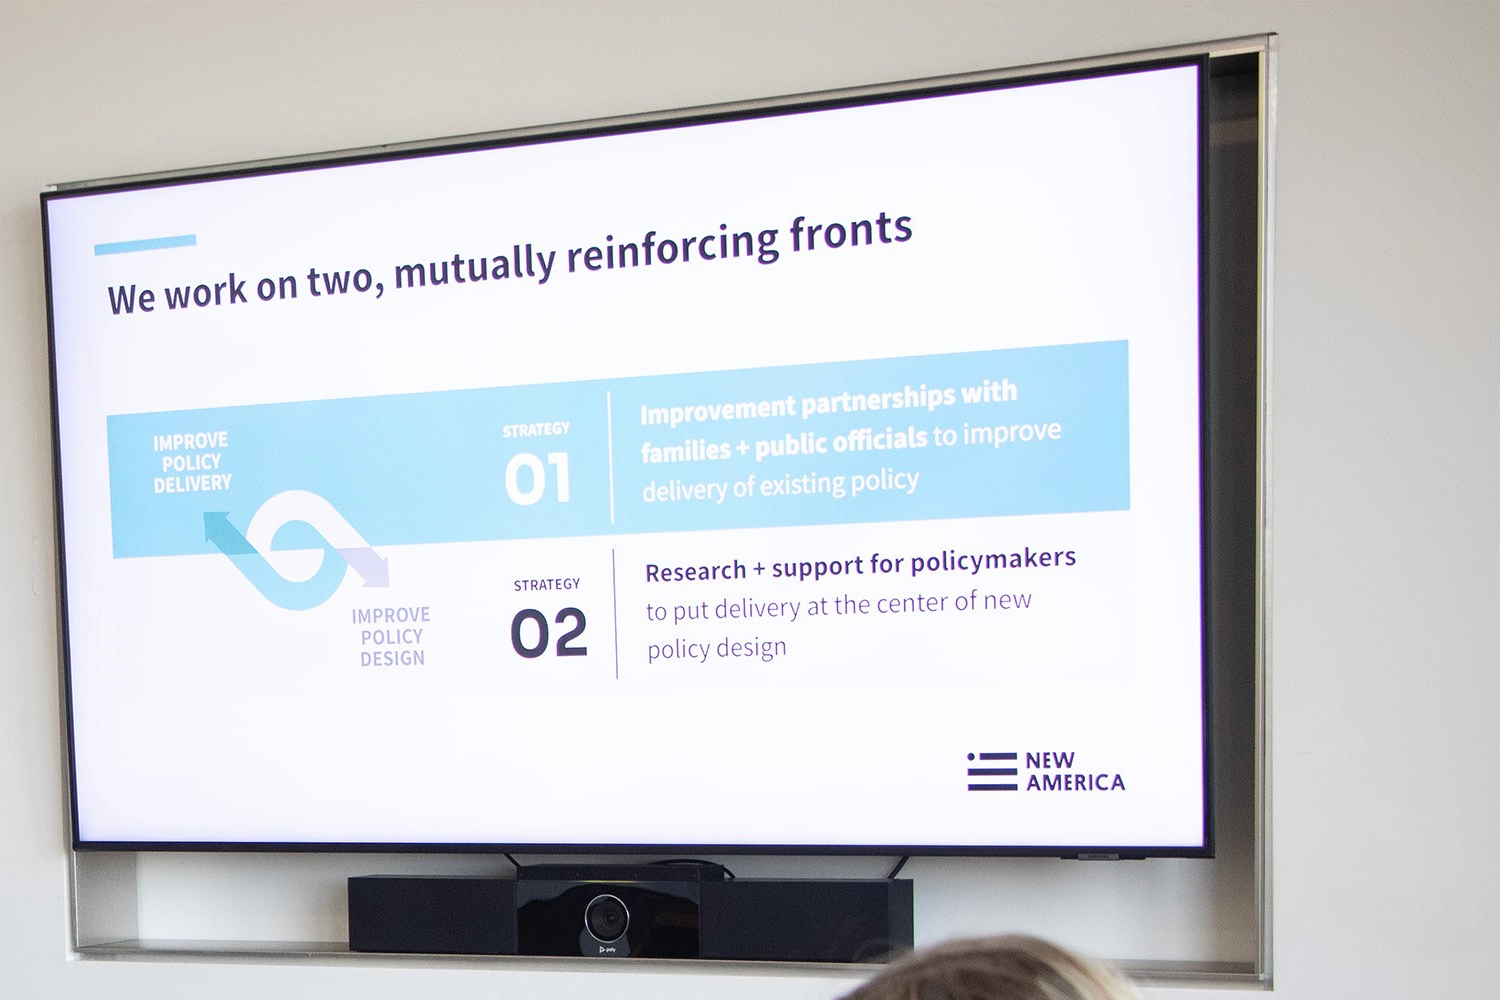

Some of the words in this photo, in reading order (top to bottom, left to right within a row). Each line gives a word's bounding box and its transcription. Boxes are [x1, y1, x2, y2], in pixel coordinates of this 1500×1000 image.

[107, 284, 156, 316] We
[163, 272, 248, 310] work
[256, 275, 298, 302] on
[306, 267, 384, 300] two,
[395, 243, 557, 289] mutually
[567, 223, 780, 273] reinforcing
[789, 211, 913, 253] fronts
[640, 395, 797, 429] Improvement
[801, 383, 956, 420] partnerships
[960, 378, 1018, 404] with
[502, 421, 570, 439] STRATEGY
[153, 431, 229, 452] IMPROVE
[640, 438, 732, 464] families
[735, 440, 750, 455] +
[755, 431, 828, 463] public
[832, 425, 928, 453] officials
[932, 426, 958, 447] to
[963, 422, 1062, 449] improve
[162, 453, 222, 472] POLICY
[154, 473, 232, 494] DELIVERY
[505, 451, 570, 506] 01
[642, 479, 729, 505] delivery
[733, 474, 756, 498] of
[759, 471, 846, 499] existing
[851, 467, 920, 497] policy
[646, 559, 746, 583] Research
[753, 561, 766, 576] +
[772, 555, 864, 582] support
[869, 552, 905, 574] for
[911, 546, 1076, 578] policymakers
[513, 577, 581, 592] STRATEGY
[352, 606, 431, 625] IMPROVE
[646, 603, 667, 622] to
[674, 601, 709, 626] put
[715, 597, 801, 623] delivery
[807, 597, 829, 616] at
[834, 593, 871, 615] the
[877, 593, 949, 614] center
[954, 588, 978, 611] of
[984, 593, 1032, 610] new
[361, 628, 424, 646] POLICY
[510, 606, 588, 659] 02
[360, 649, 425, 667] DESIGN
[648, 638, 711, 665] policy
[716, 636, 786, 663] design
[1026, 751, 1075, 769] NEW
[1026, 773, 1126, 792] AMERICA
